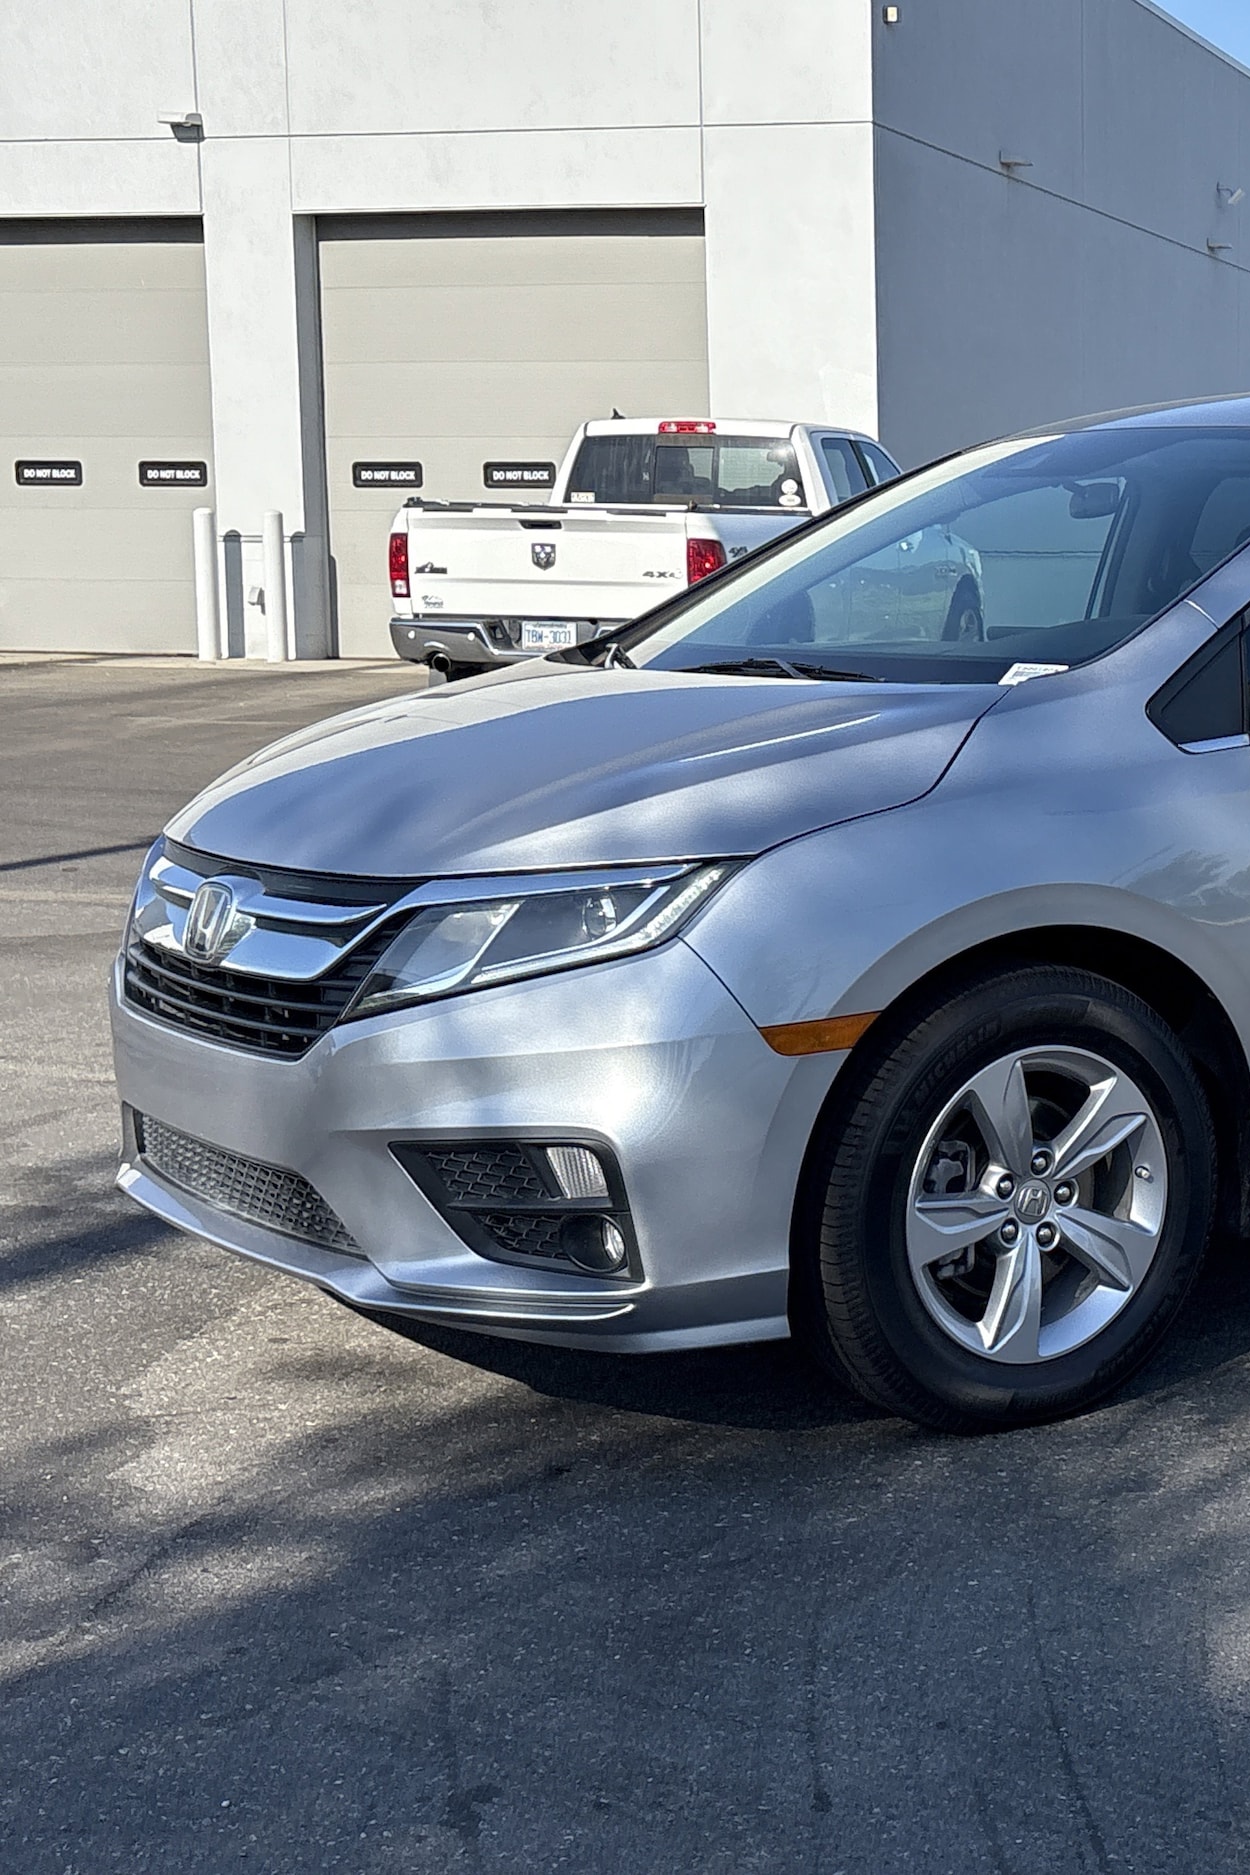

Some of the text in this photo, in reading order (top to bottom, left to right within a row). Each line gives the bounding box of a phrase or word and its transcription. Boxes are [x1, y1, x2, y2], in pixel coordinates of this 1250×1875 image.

[23, 469, 76, 479] DO NOT BLOCK
[146, 469, 200, 479] DO NOT BLOCK
[360, 470, 415, 481] DO NOT BLOCK
[492, 470, 549, 481] DO NOT BLOCK
